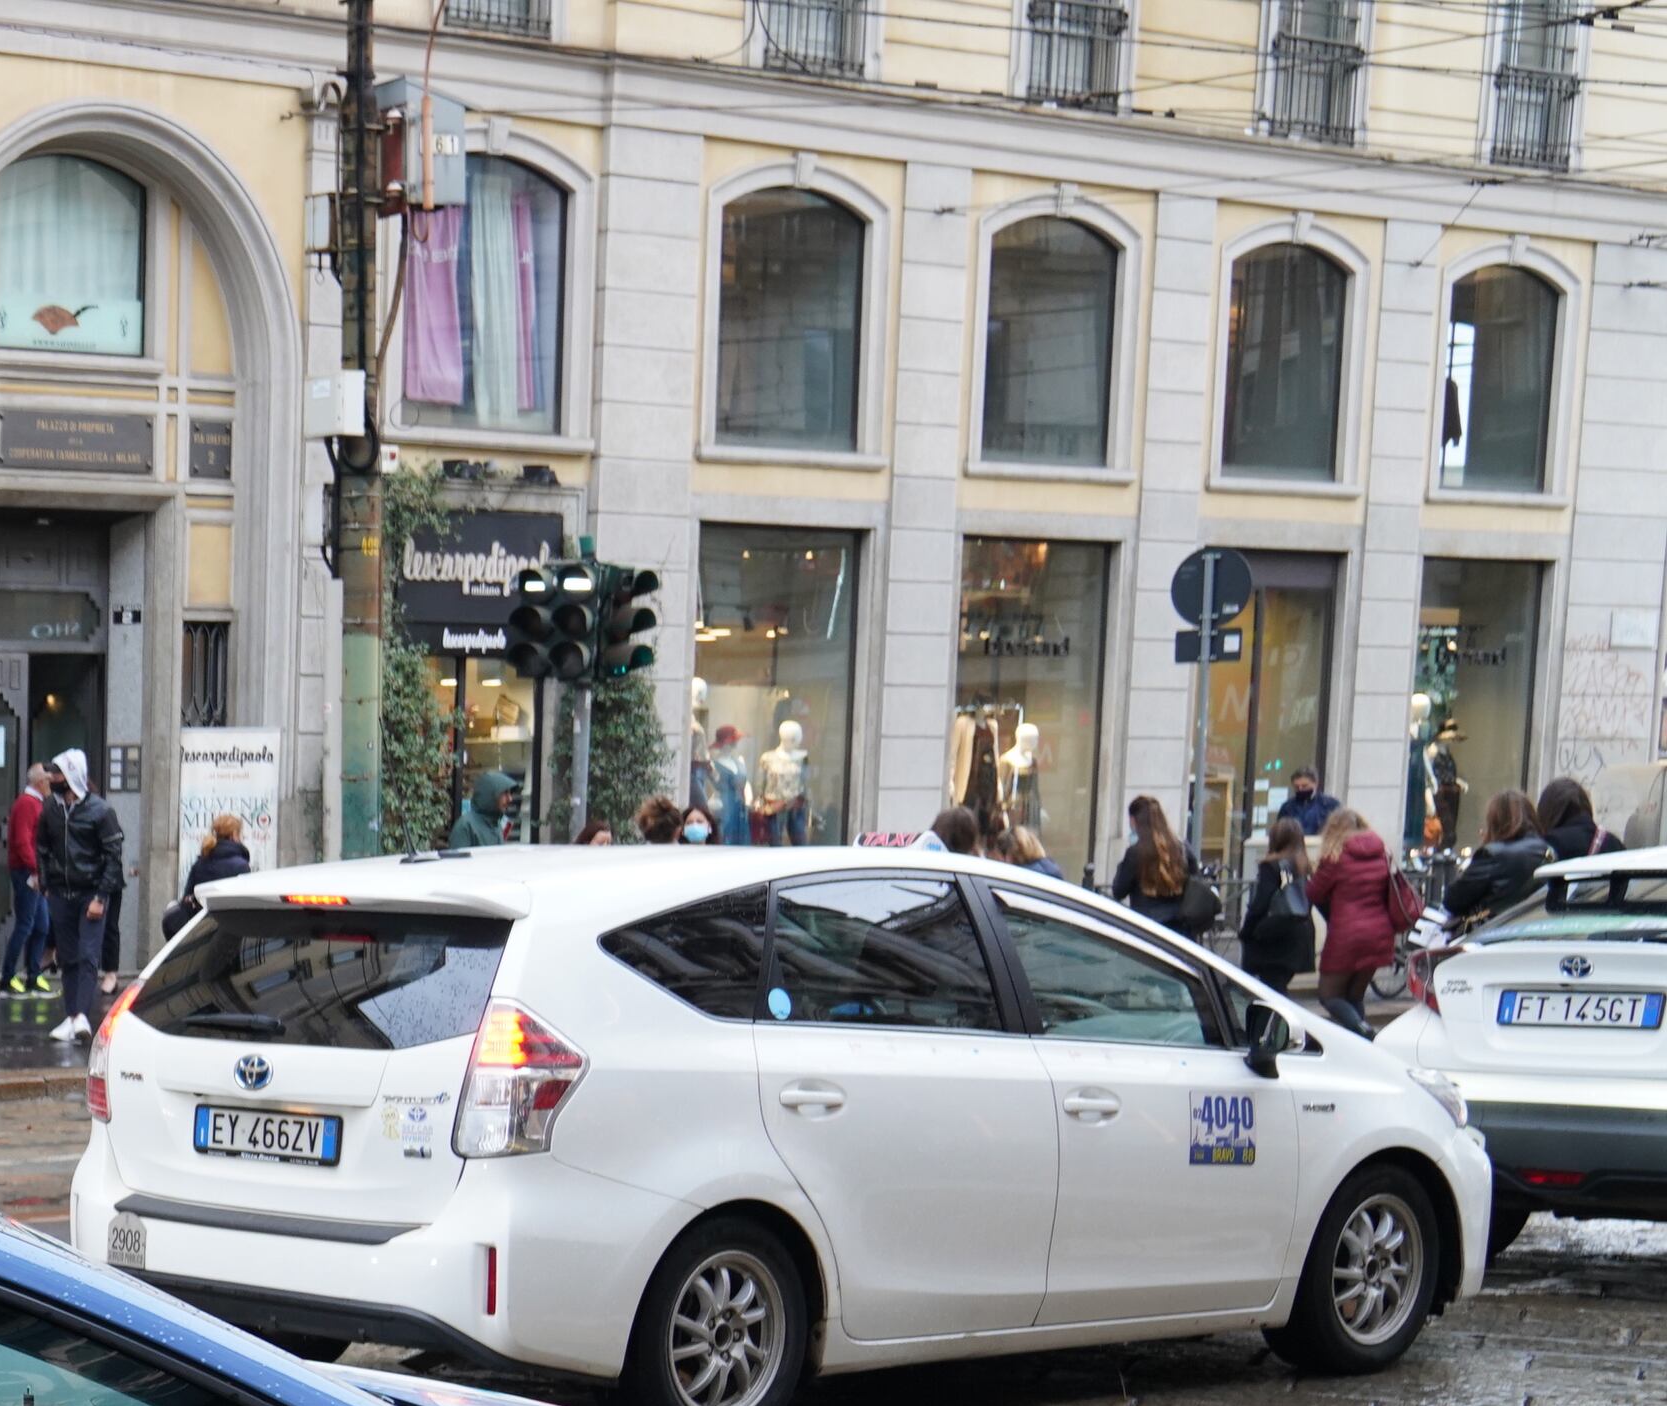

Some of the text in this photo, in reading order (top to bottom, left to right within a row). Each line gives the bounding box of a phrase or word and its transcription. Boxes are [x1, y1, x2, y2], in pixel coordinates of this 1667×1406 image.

[180, 796, 270, 812] SOUVENIR
[863, 832, 920, 848] TAXI
[1517, 996, 1551, 1021] FT
[1564, 996, 1642, 1023] 145GT
[1201, 1096, 1254, 1139] 4040
[212, 1112, 240, 1146] EY
[247, 1116, 320, 1153] 466ZV
[1212, 1147, 1235, 1163] BRAVO
[112, 1226, 141, 1254] 2908
